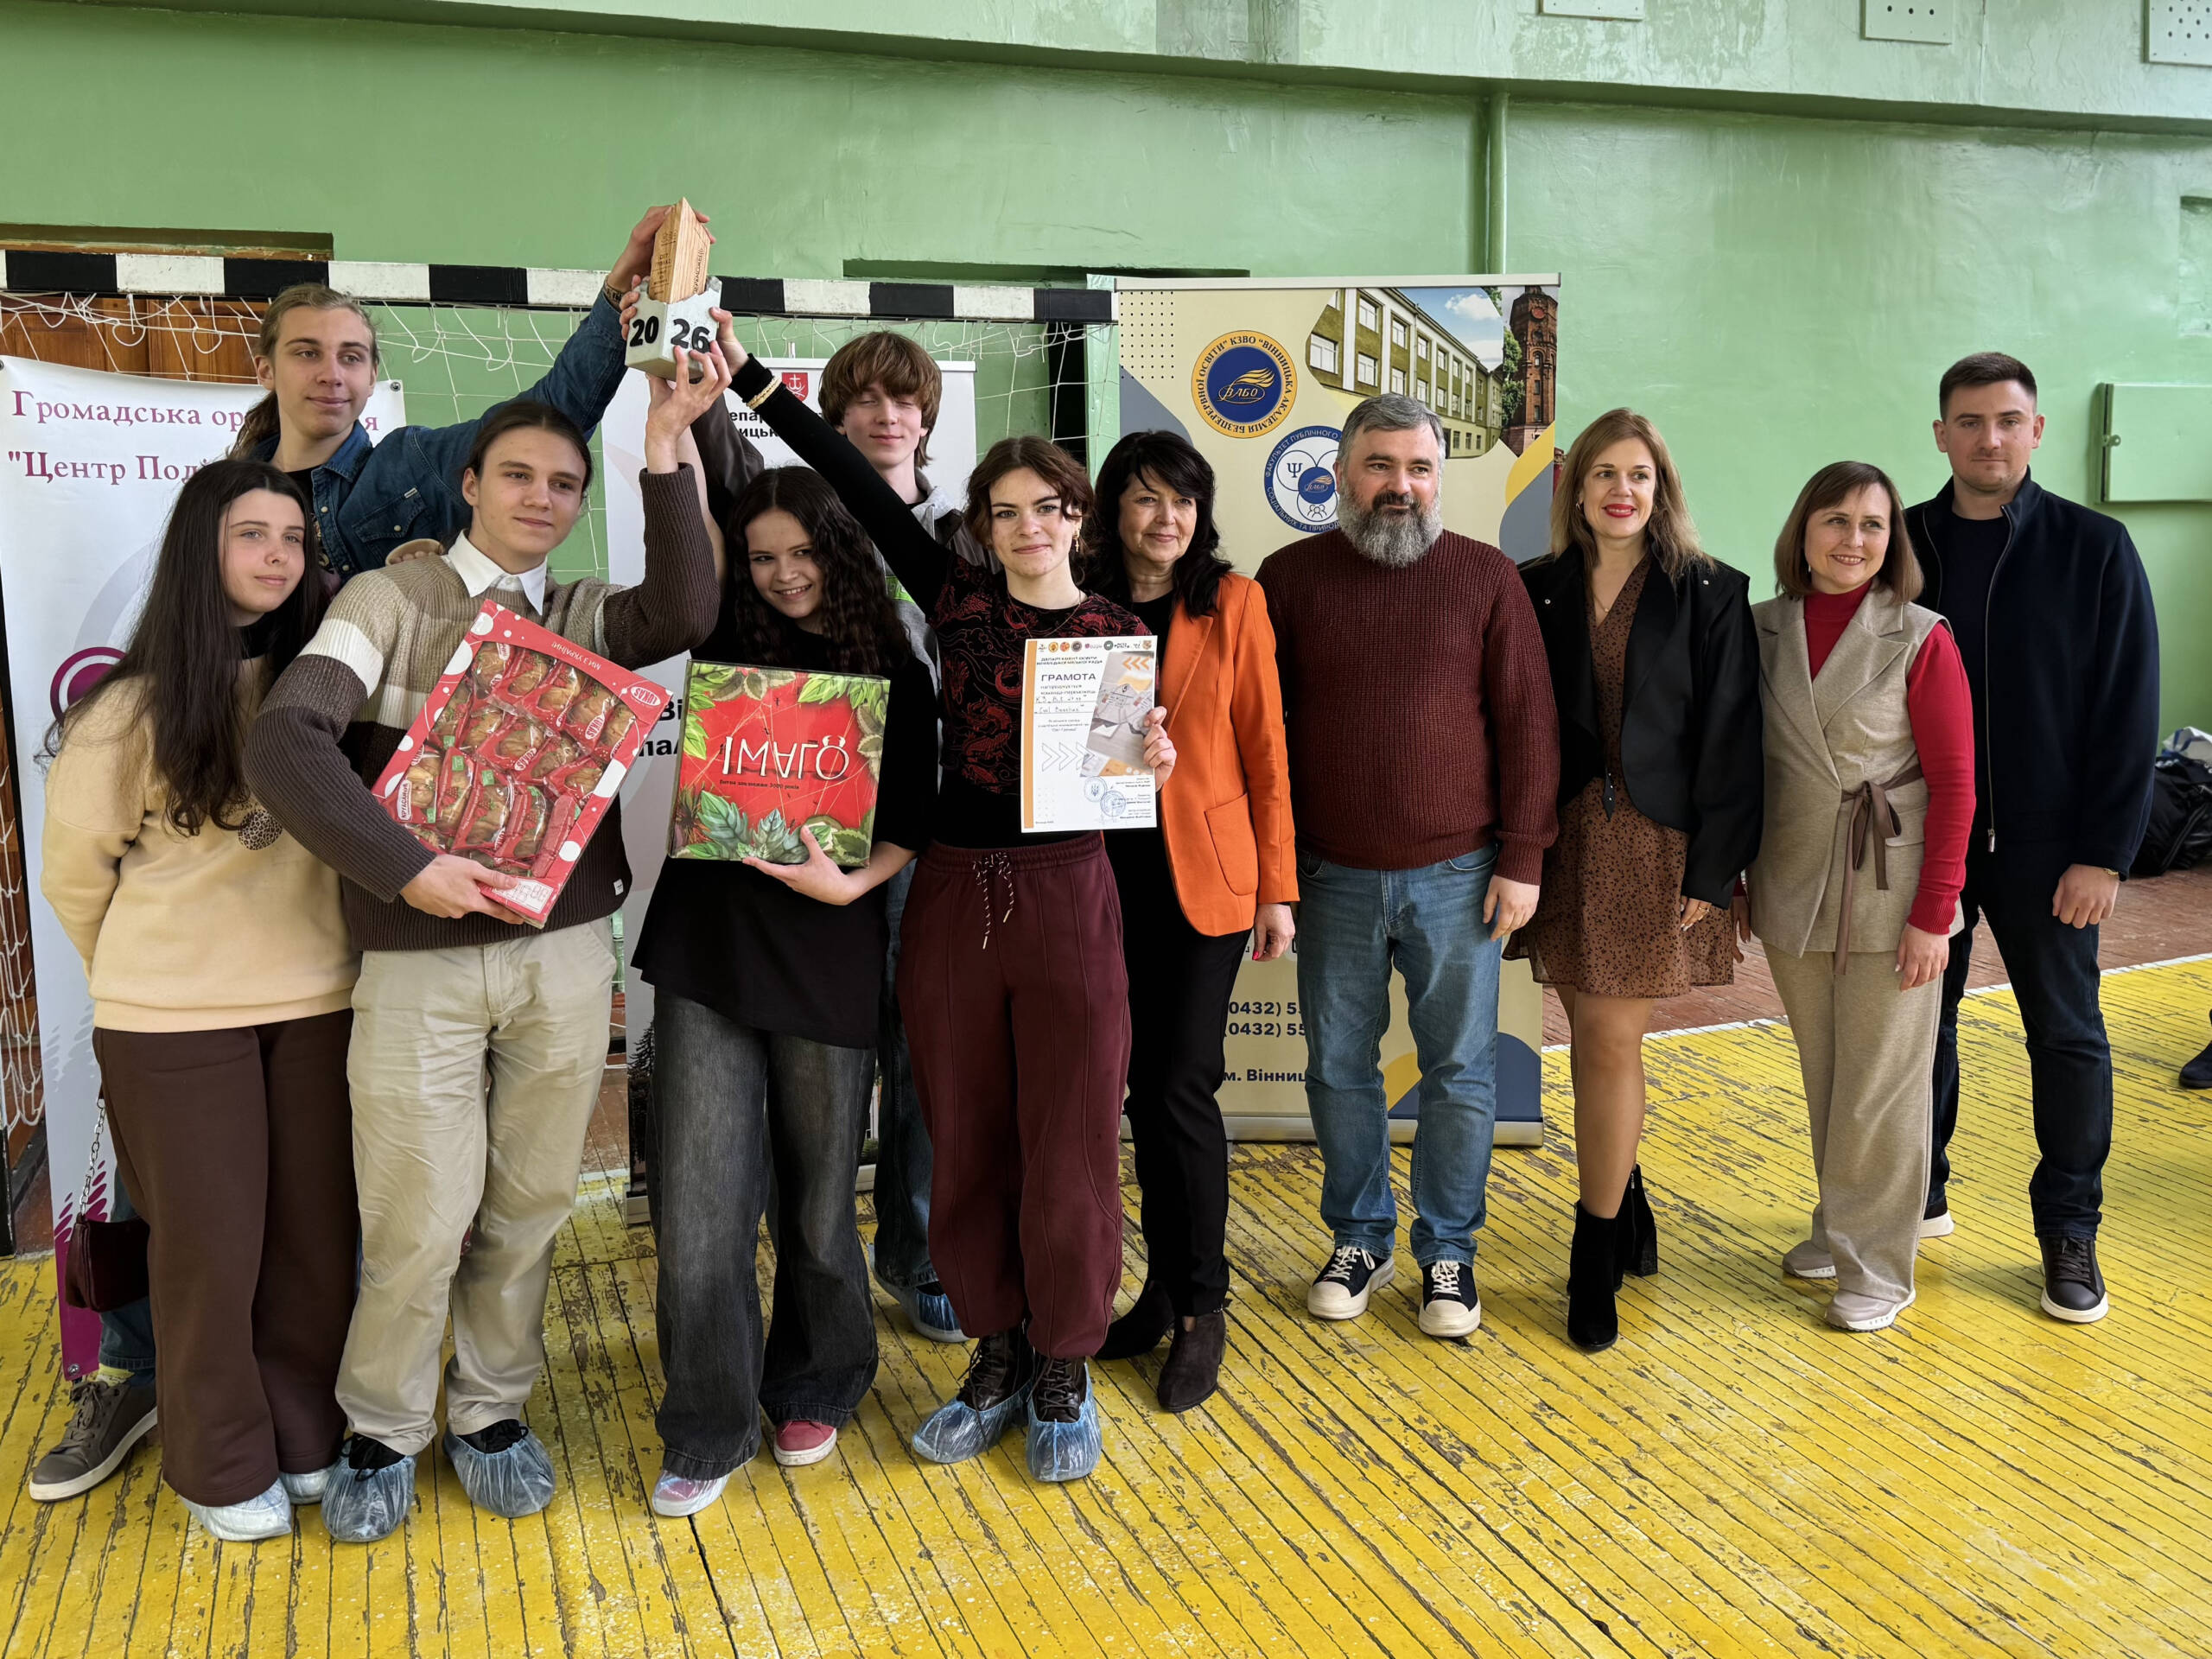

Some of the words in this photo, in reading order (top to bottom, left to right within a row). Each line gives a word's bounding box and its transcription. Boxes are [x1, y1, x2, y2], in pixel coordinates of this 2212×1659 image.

[629, 315, 659, 347] 20
[671, 318, 710, 353] 26
[1230, 335, 1256, 346] КЗВО
[1249, 396, 1289, 433] АКАДЕМІЯ
[12, 391, 202, 426] Громадська
[1309, 519, 1340, 531] ПРИРОД
[1041, 673, 1096, 682] ГРАМОТА
[632, 687, 658, 705] LUKAS
[1228, 1001, 1281, 1017] 0432)
[1224, 1022, 1281, 1038] 0432)
